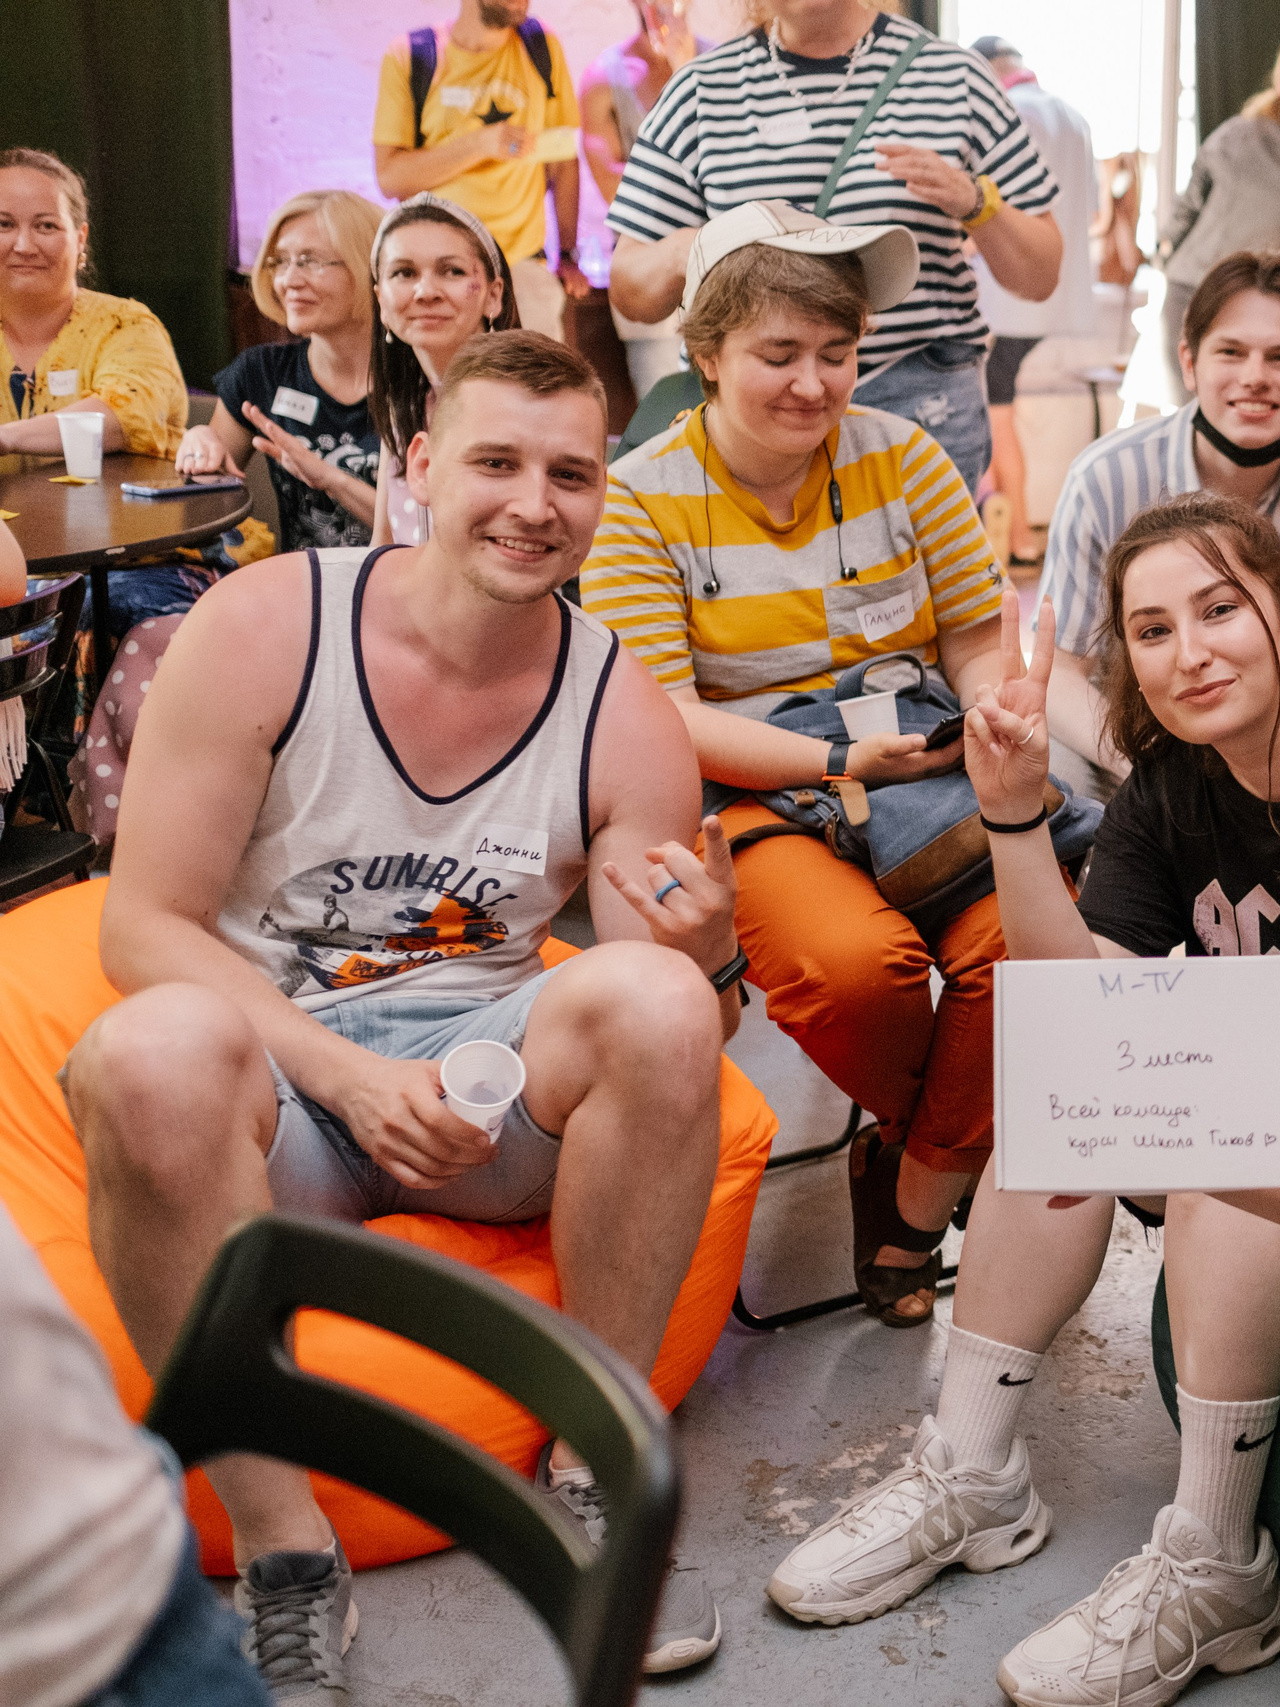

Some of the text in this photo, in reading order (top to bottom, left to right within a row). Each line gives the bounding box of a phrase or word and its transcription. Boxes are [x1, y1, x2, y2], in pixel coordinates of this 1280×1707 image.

[475, 836, 543, 861] Джонни
[330, 852, 519, 910] SUNRIS
[1116, 1040, 1136, 1071] 3
